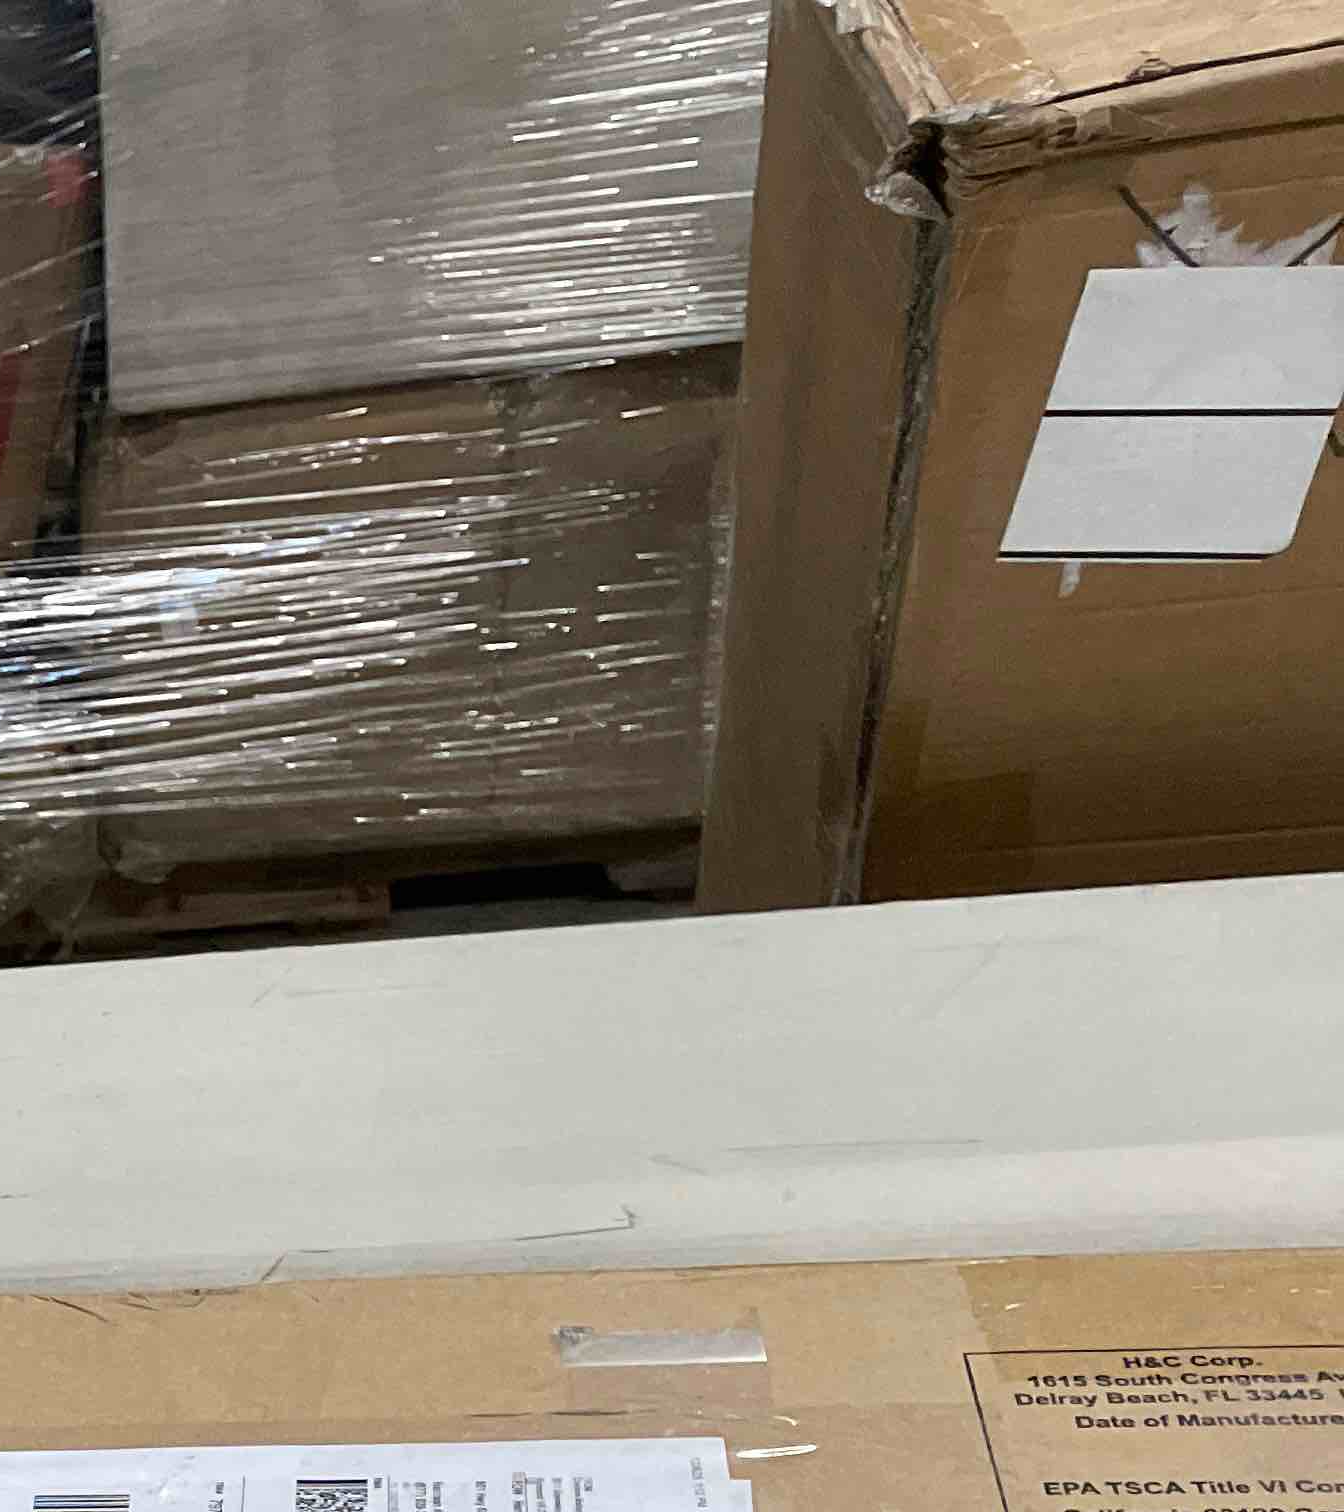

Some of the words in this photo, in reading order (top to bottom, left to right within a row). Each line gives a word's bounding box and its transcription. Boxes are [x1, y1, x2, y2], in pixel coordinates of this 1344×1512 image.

[1122, 1356, 1184, 1369] H&C
[1190, 1355, 1264, 1369] Corp.
[1028, 1375, 1087, 1388] 1615
[1095, 1374, 1172, 1387] South
[1015, 1393, 1097, 1407] Delray
[1107, 1390, 1198, 1405] Beach,
[1202, 1390, 1240, 1402] FL
[1246, 1389, 1324, 1401] 33445
[1075, 1415, 1136, 1429] Date
[1144, 1415, 1169, 1428] of
[1043, 1481, 1101, 1496] EPA
[1104, 1481, 1186, 1495] TSCA
[1191, 1480, 1251, 1495] Title
[1257, 1480, 1287, 1494] VI
